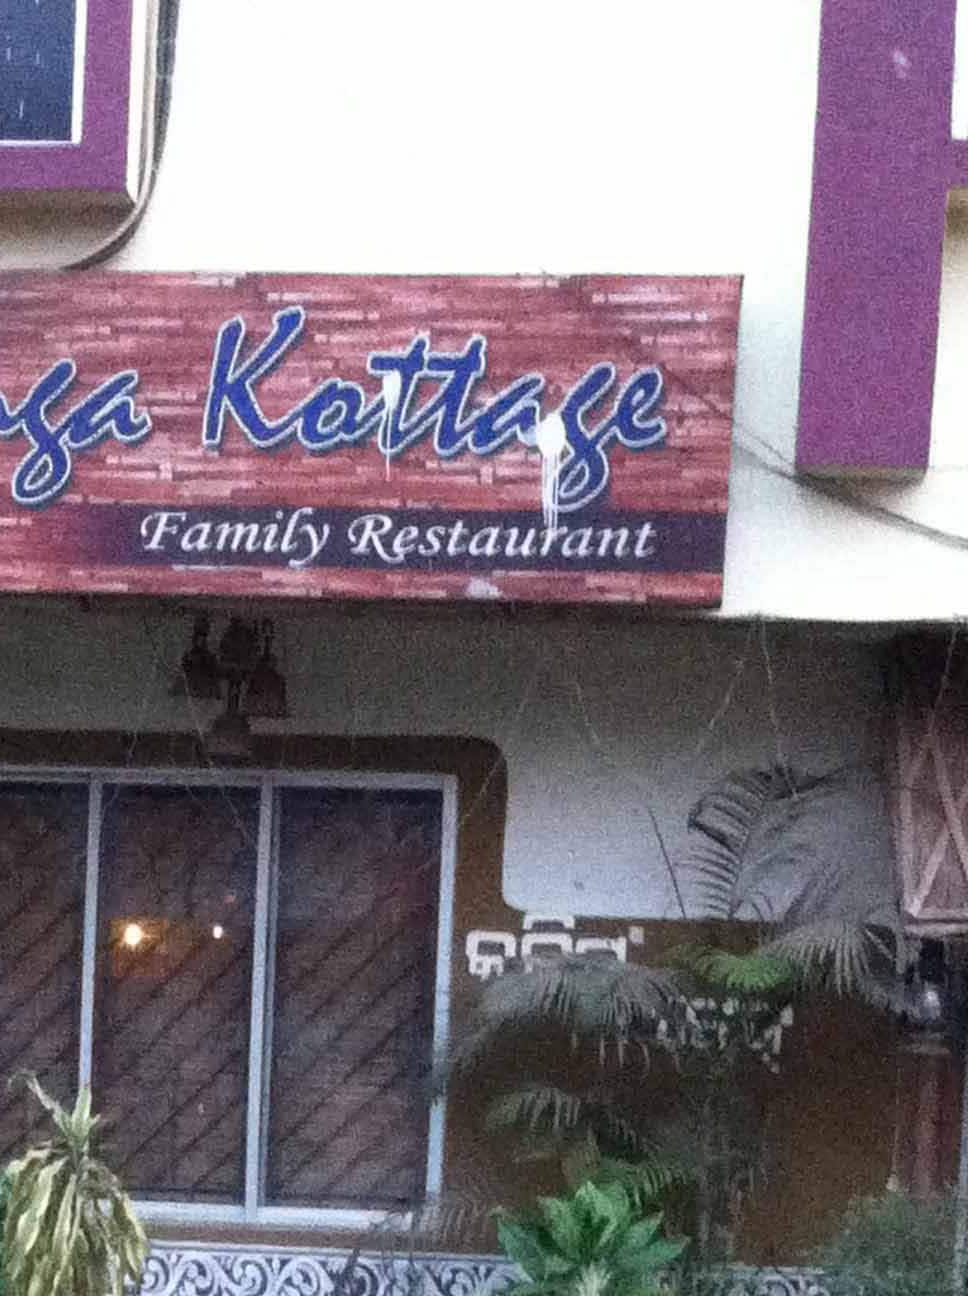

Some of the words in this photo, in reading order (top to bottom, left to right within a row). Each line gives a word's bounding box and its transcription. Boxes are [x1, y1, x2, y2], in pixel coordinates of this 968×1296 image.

[202, 306, 669, 511] Kottage
[139, 507, 329, 568] Family
[347, 512, 657, 562] Restaurant
